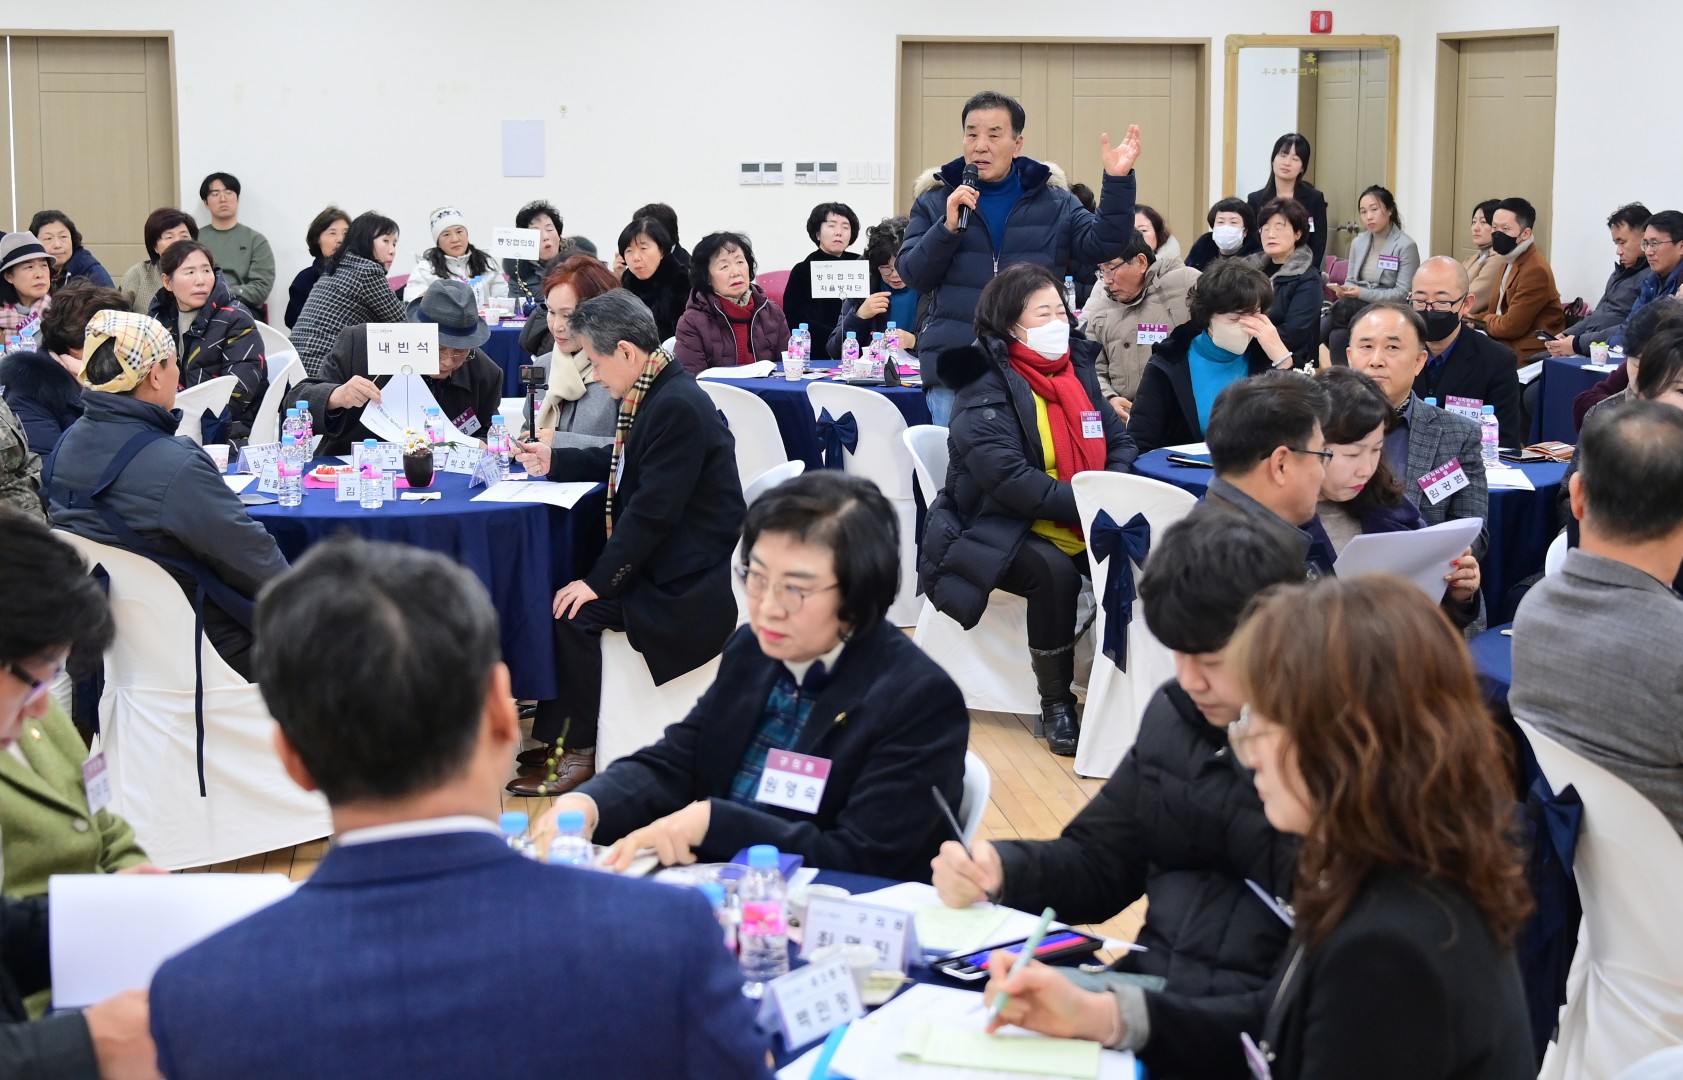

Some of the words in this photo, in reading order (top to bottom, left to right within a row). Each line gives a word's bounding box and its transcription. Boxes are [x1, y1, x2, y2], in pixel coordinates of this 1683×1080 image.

[820, 284, 862, 293] 자율방재단
[378, 341, 429, 354] 내빈석
[1428, 473, 1464, 499] 임광범
